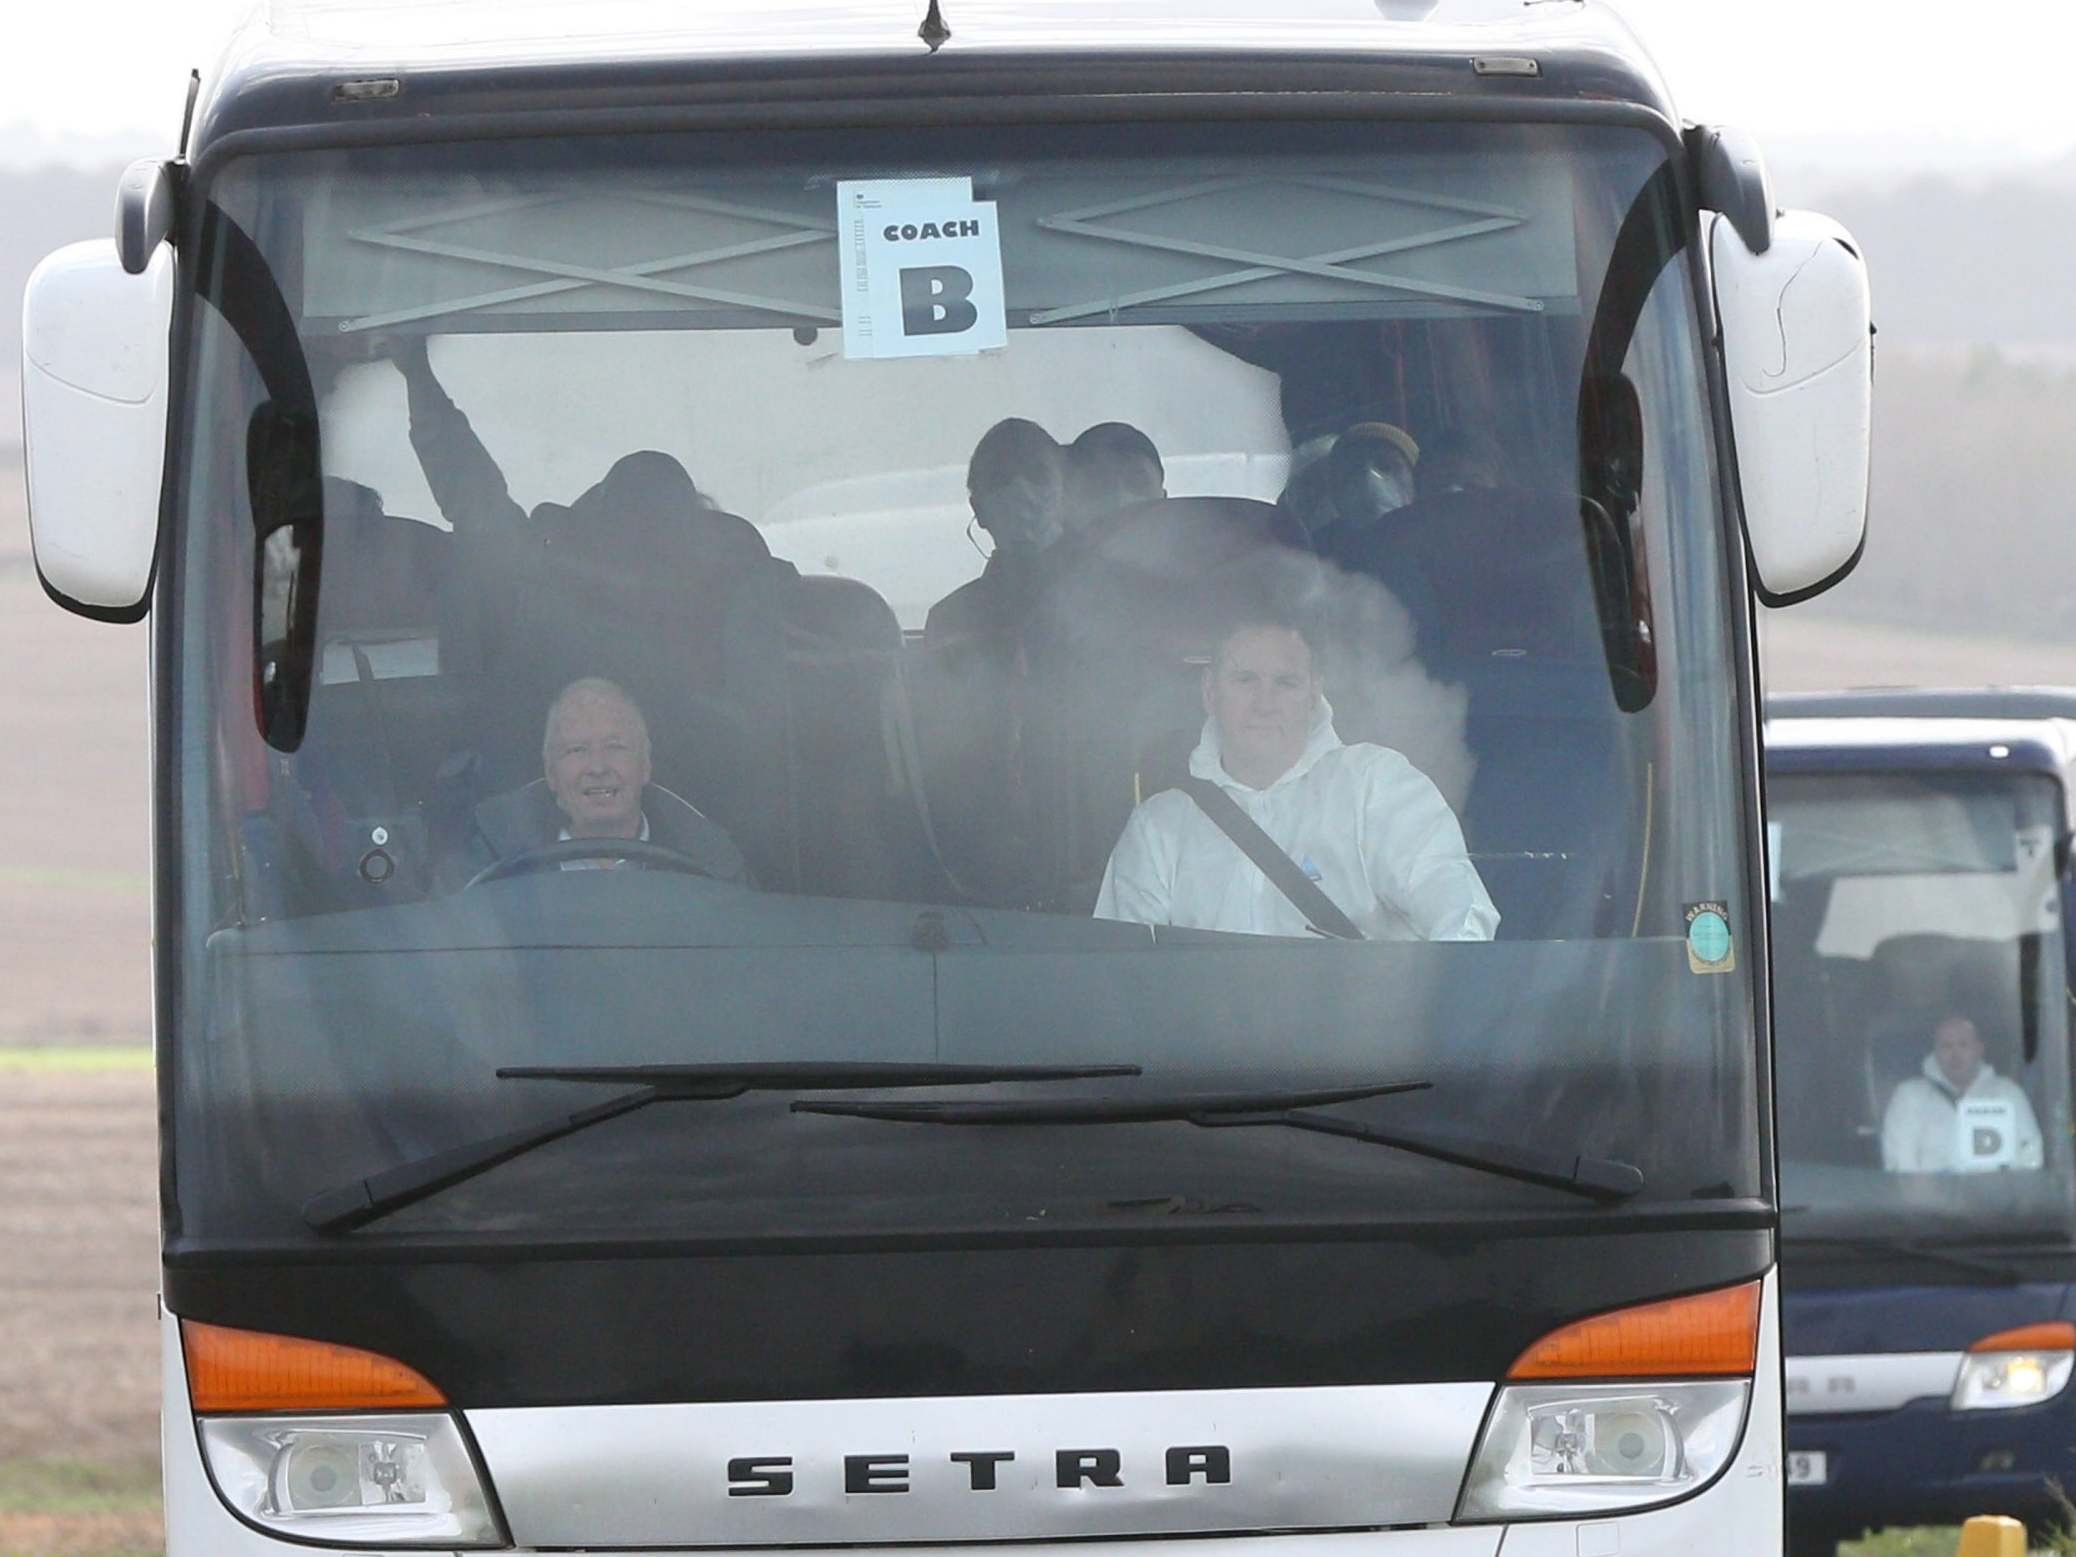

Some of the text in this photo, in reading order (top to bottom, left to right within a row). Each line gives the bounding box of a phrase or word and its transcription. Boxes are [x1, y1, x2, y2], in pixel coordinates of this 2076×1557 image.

[883, 219, 980, 242] COACH
[899, 265, 978, 336] B
[1685, 903, 1729, 921] WARNING
[1973, 1127, 2002, 1156] D
[727, 1445, 1231, 1496] SETRA
